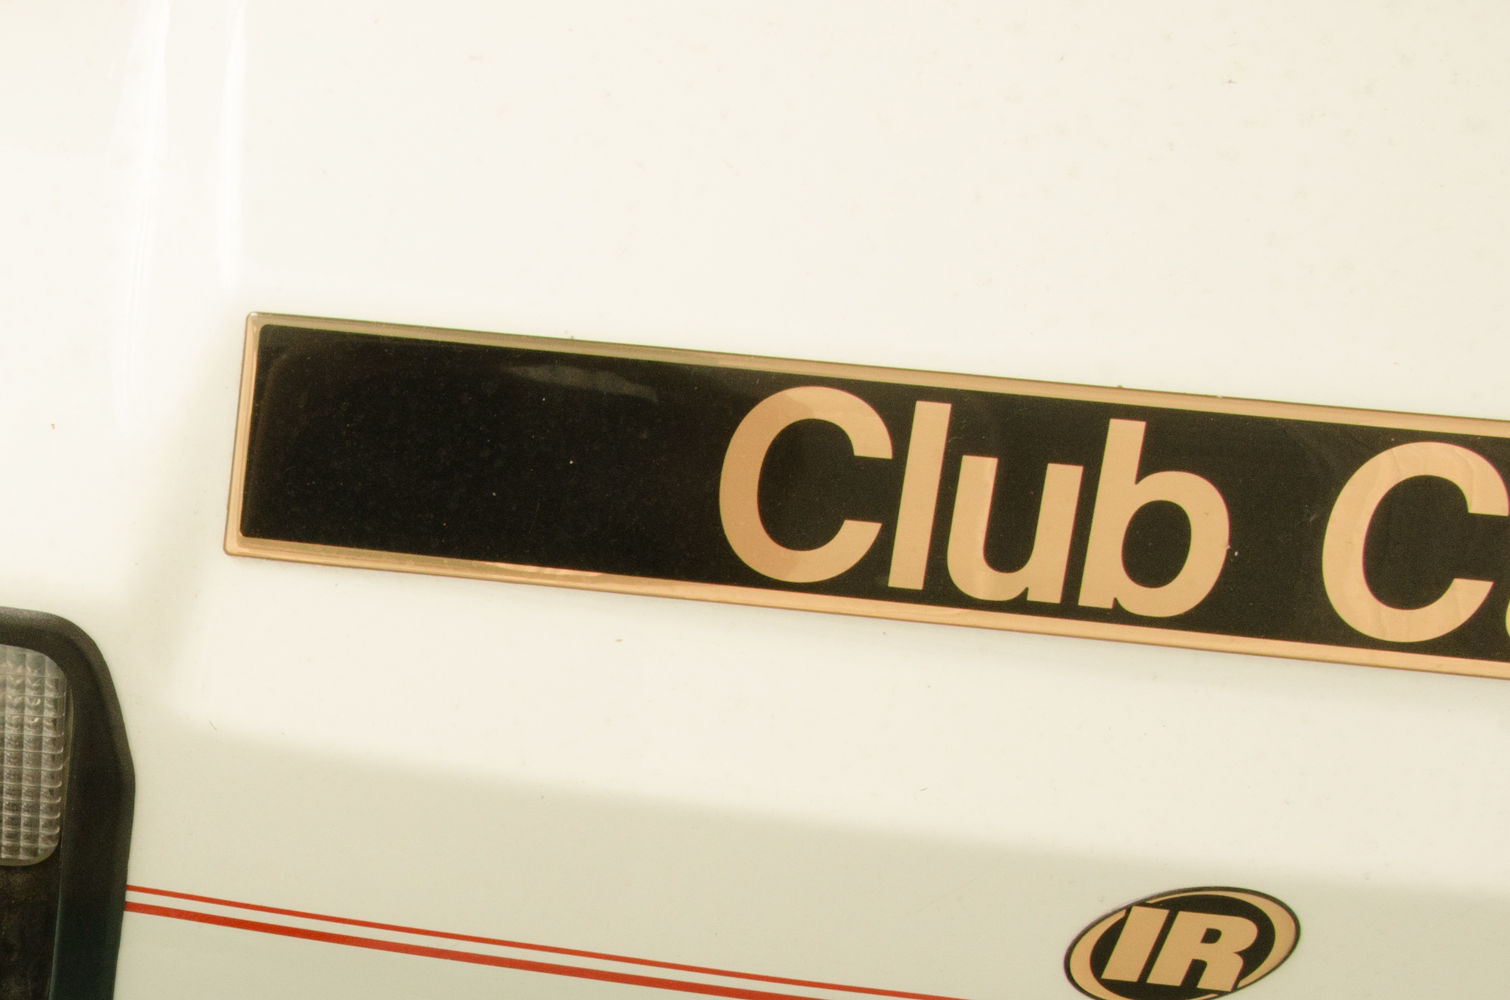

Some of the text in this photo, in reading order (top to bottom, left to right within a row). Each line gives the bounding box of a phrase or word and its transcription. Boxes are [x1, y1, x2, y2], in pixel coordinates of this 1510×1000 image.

[719, 385, 1510, 643] Club C
[1101, 905, 1258, 992] IR
